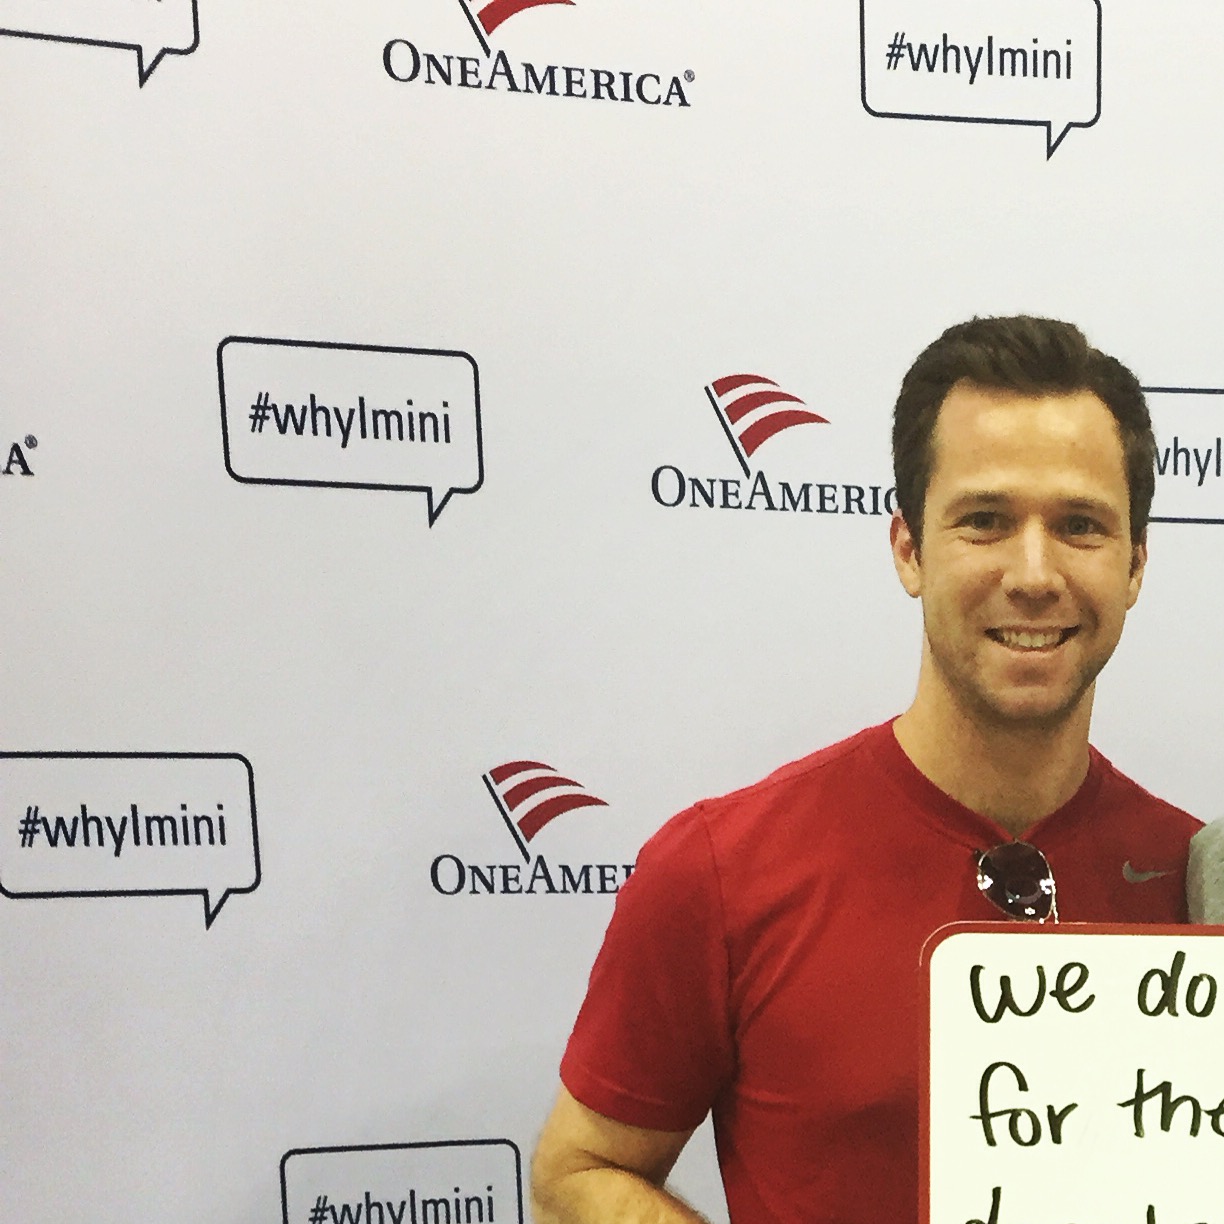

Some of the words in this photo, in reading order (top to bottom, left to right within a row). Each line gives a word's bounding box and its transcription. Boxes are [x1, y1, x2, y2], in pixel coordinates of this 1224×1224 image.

[886, 31, 1072, 86] #whyImini
[249, 391, 451, 449] #whyImini
[18, 802, 227, 858] #whyImini
[970, 962, 1096, 1024] we
[1137, 951, 1218, 1018] do
[969, 1061, 1079, 1148] for
